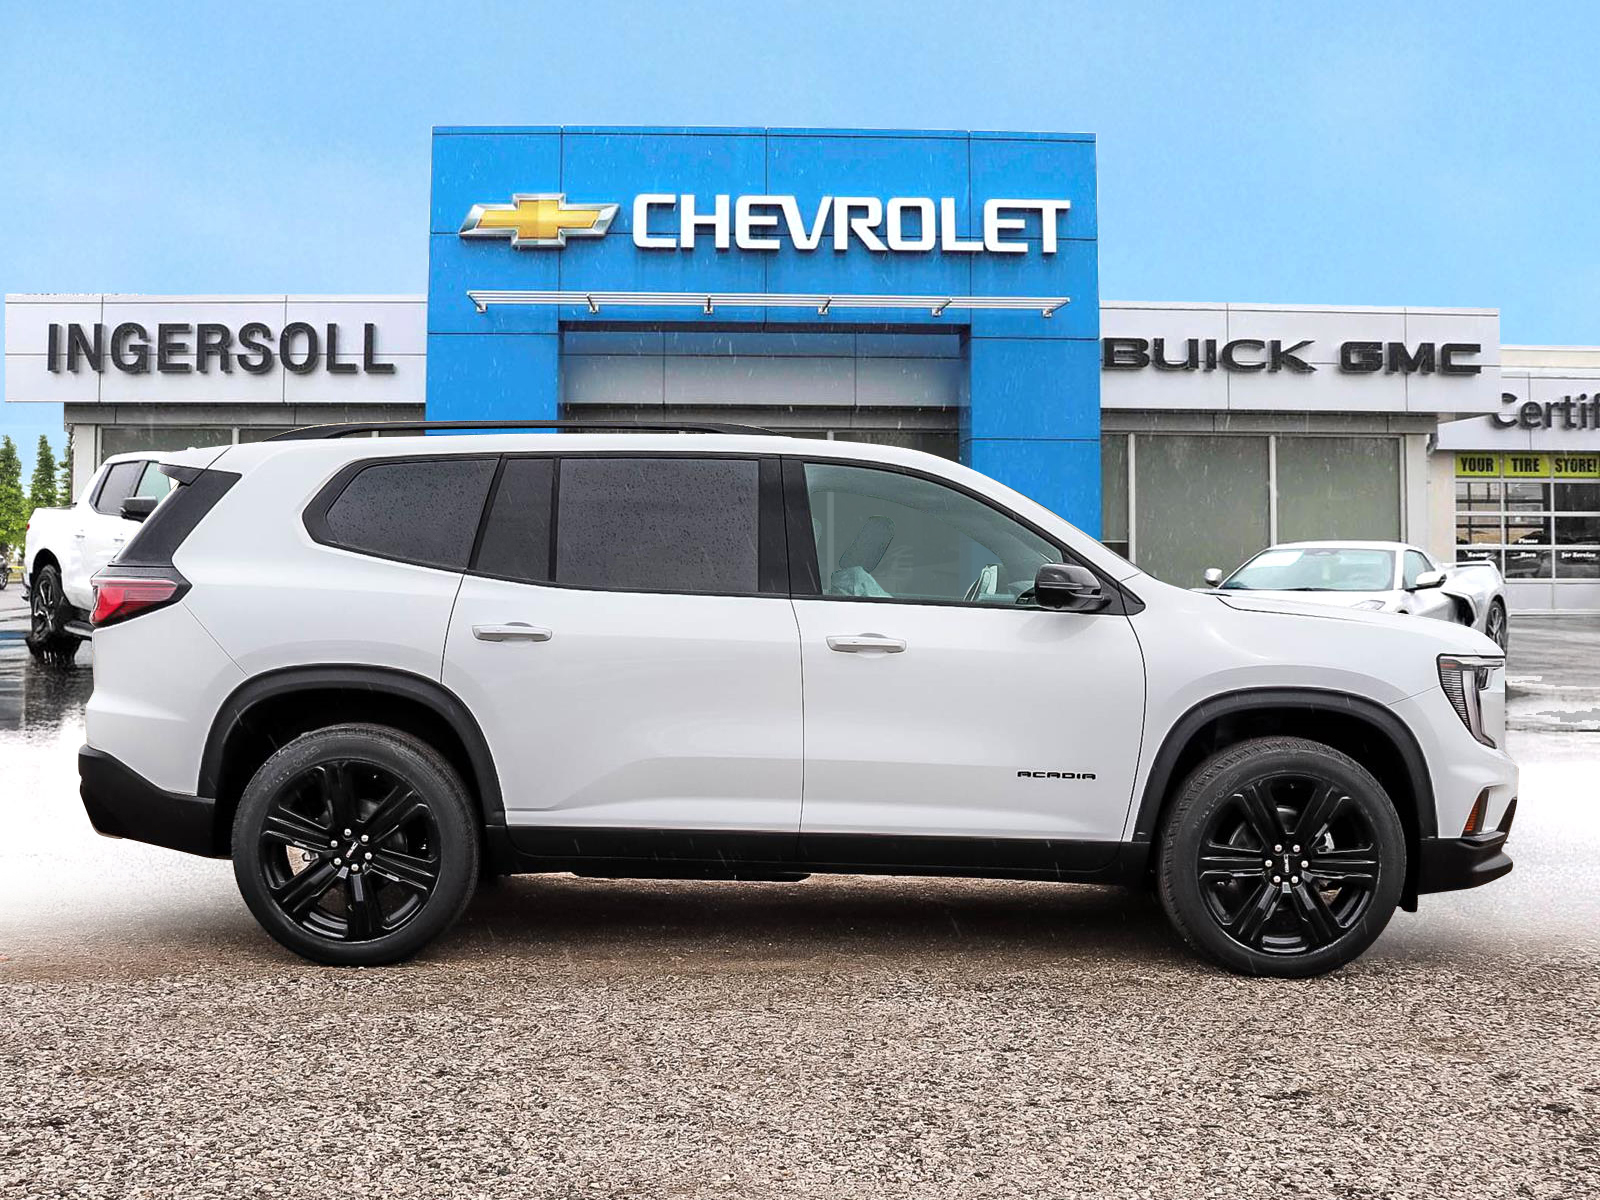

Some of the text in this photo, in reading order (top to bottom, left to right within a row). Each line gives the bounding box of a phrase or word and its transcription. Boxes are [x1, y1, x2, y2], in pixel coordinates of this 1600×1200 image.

[632, 193, 1071, 254] CHEVROLET
[47, 322, 395, 375] INGERSOLL
[1102, 337, 1482, 375] BUICK GMC
[1460, 457, 1597, 473] YOUR TIRE STORE!
[1017, 771, 1097, 780] ACADIA
